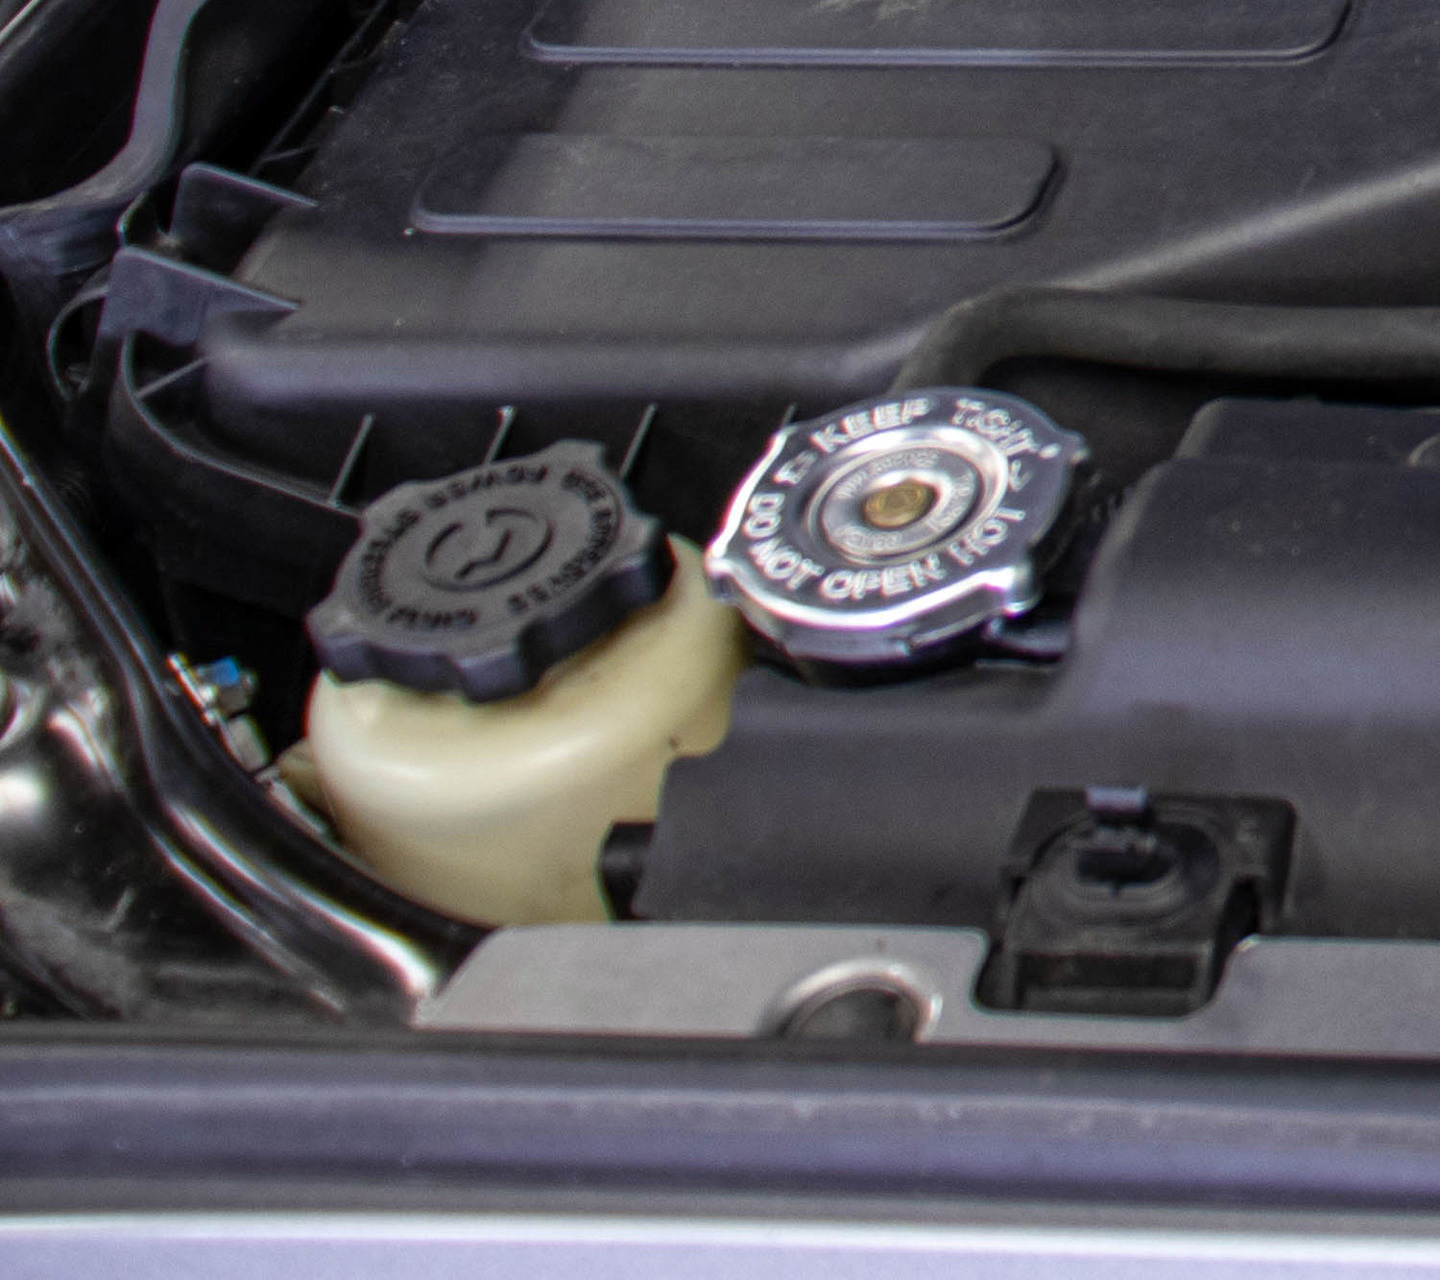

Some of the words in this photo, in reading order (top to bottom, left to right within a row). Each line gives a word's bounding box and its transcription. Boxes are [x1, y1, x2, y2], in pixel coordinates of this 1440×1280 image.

[811, 397, 931, 454] KEEP
[741, 492, 786, 539] DO
[948, 507, 1027, 566] HOT
[749, 539, 826, 590] NOT
[820, 553, 948, 600] OPEN
